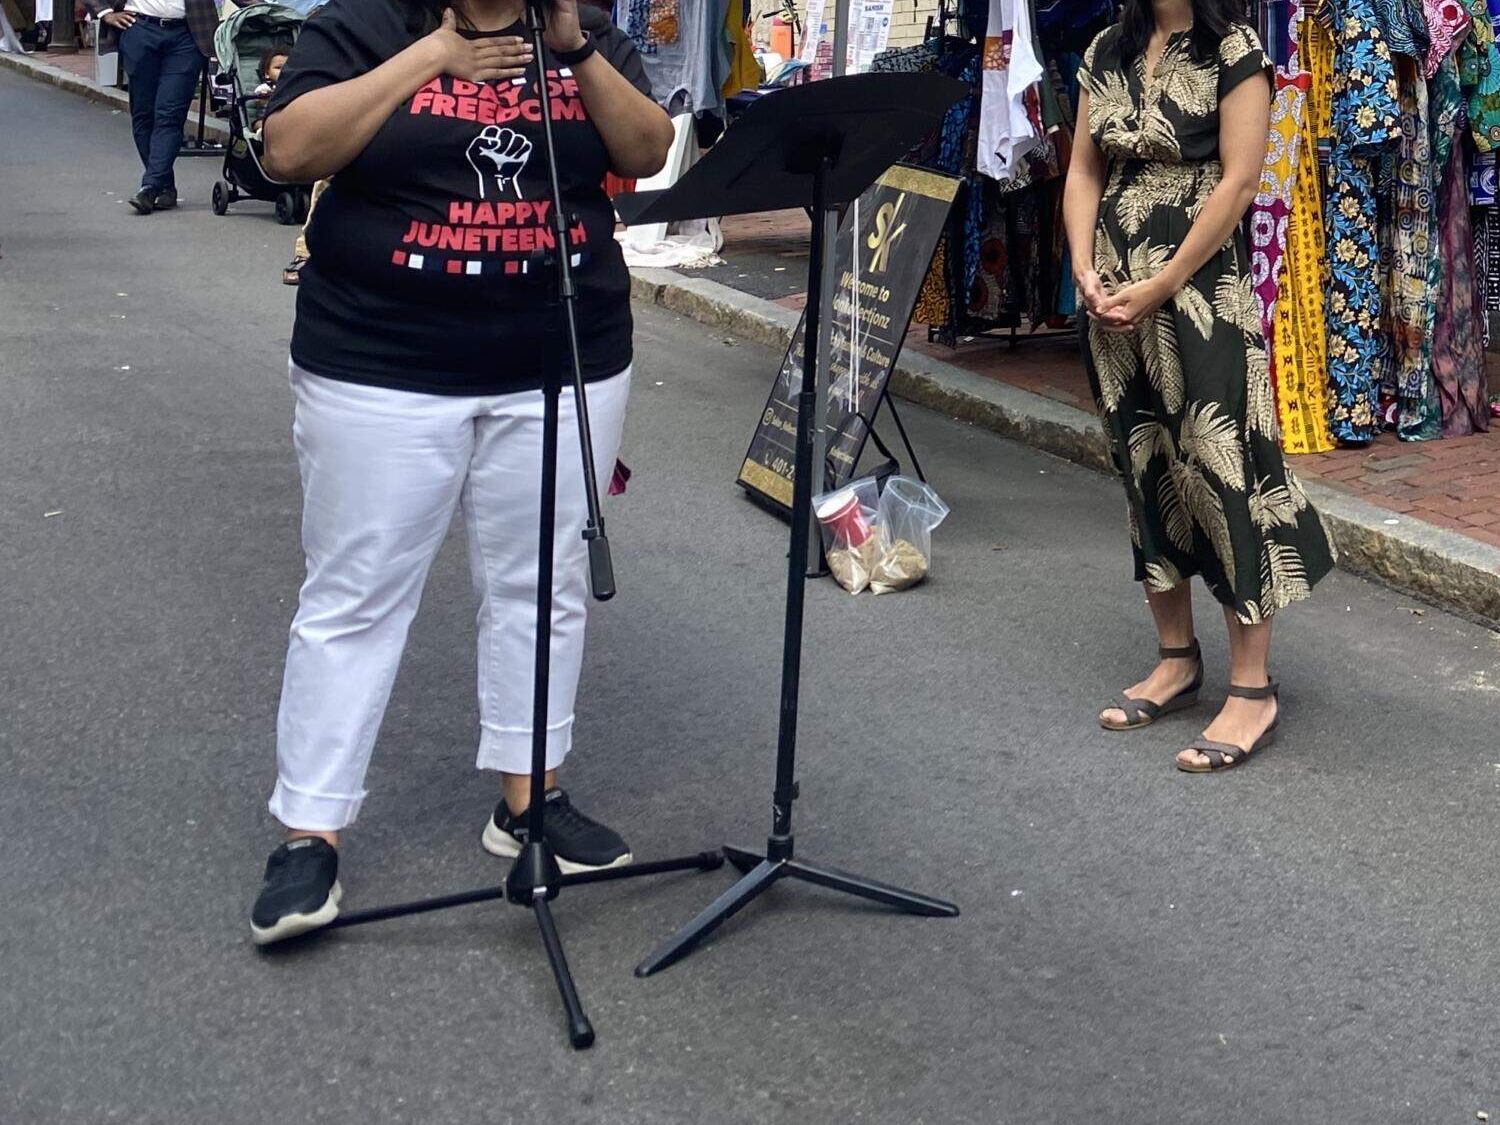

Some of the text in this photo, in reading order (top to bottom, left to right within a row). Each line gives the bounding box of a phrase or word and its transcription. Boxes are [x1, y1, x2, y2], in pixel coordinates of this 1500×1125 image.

[453, 78, 523, 106] DAY
[533, 79, 580, 98] OF
[410, 93, 586, 124] FREEDOM
[450, 201, 551, 225] HAPPY
[403, 221, 588, 251] JUNETEENH
[840, 271, 890, 302] Wecome to
[772, 457, 795, 478] 401-2
